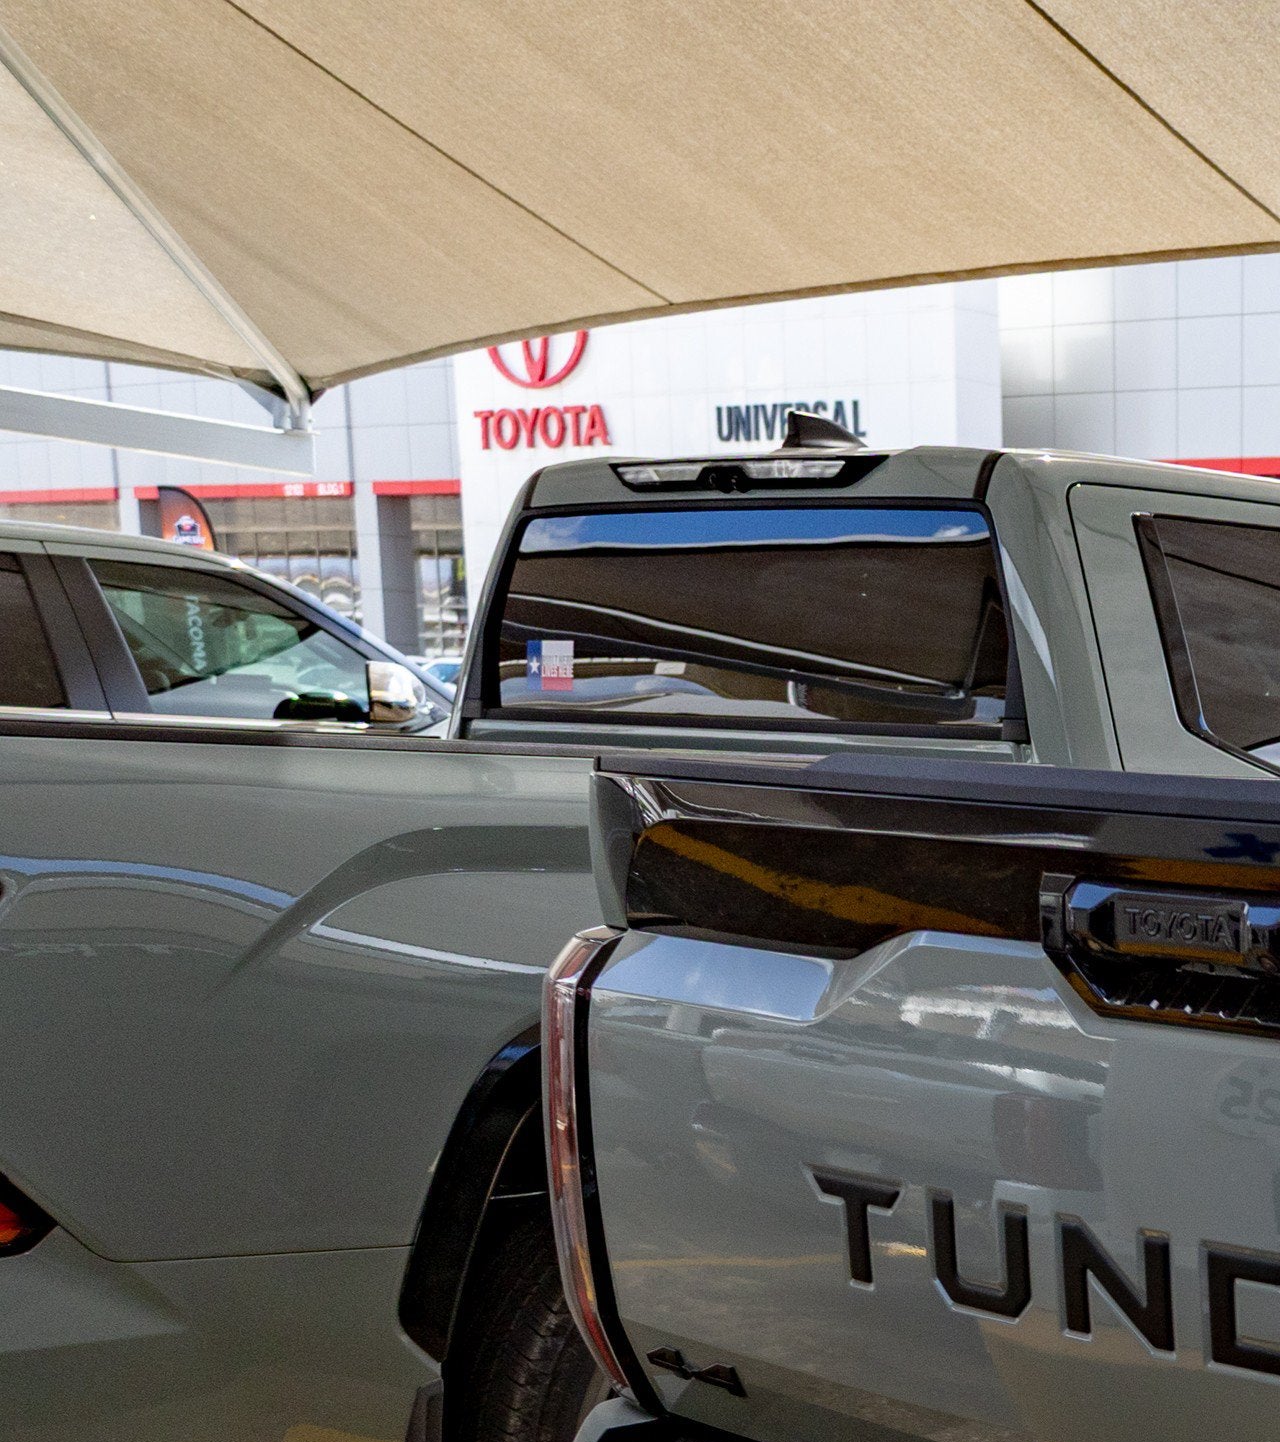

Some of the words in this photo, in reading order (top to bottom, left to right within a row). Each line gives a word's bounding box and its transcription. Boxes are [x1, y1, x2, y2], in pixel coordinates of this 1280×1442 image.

[473, 404, 612, 451] TOYOTA
[184, 595, 207, 671] TACOMA
[1124, 907, 1237, 950] TOYOTA
